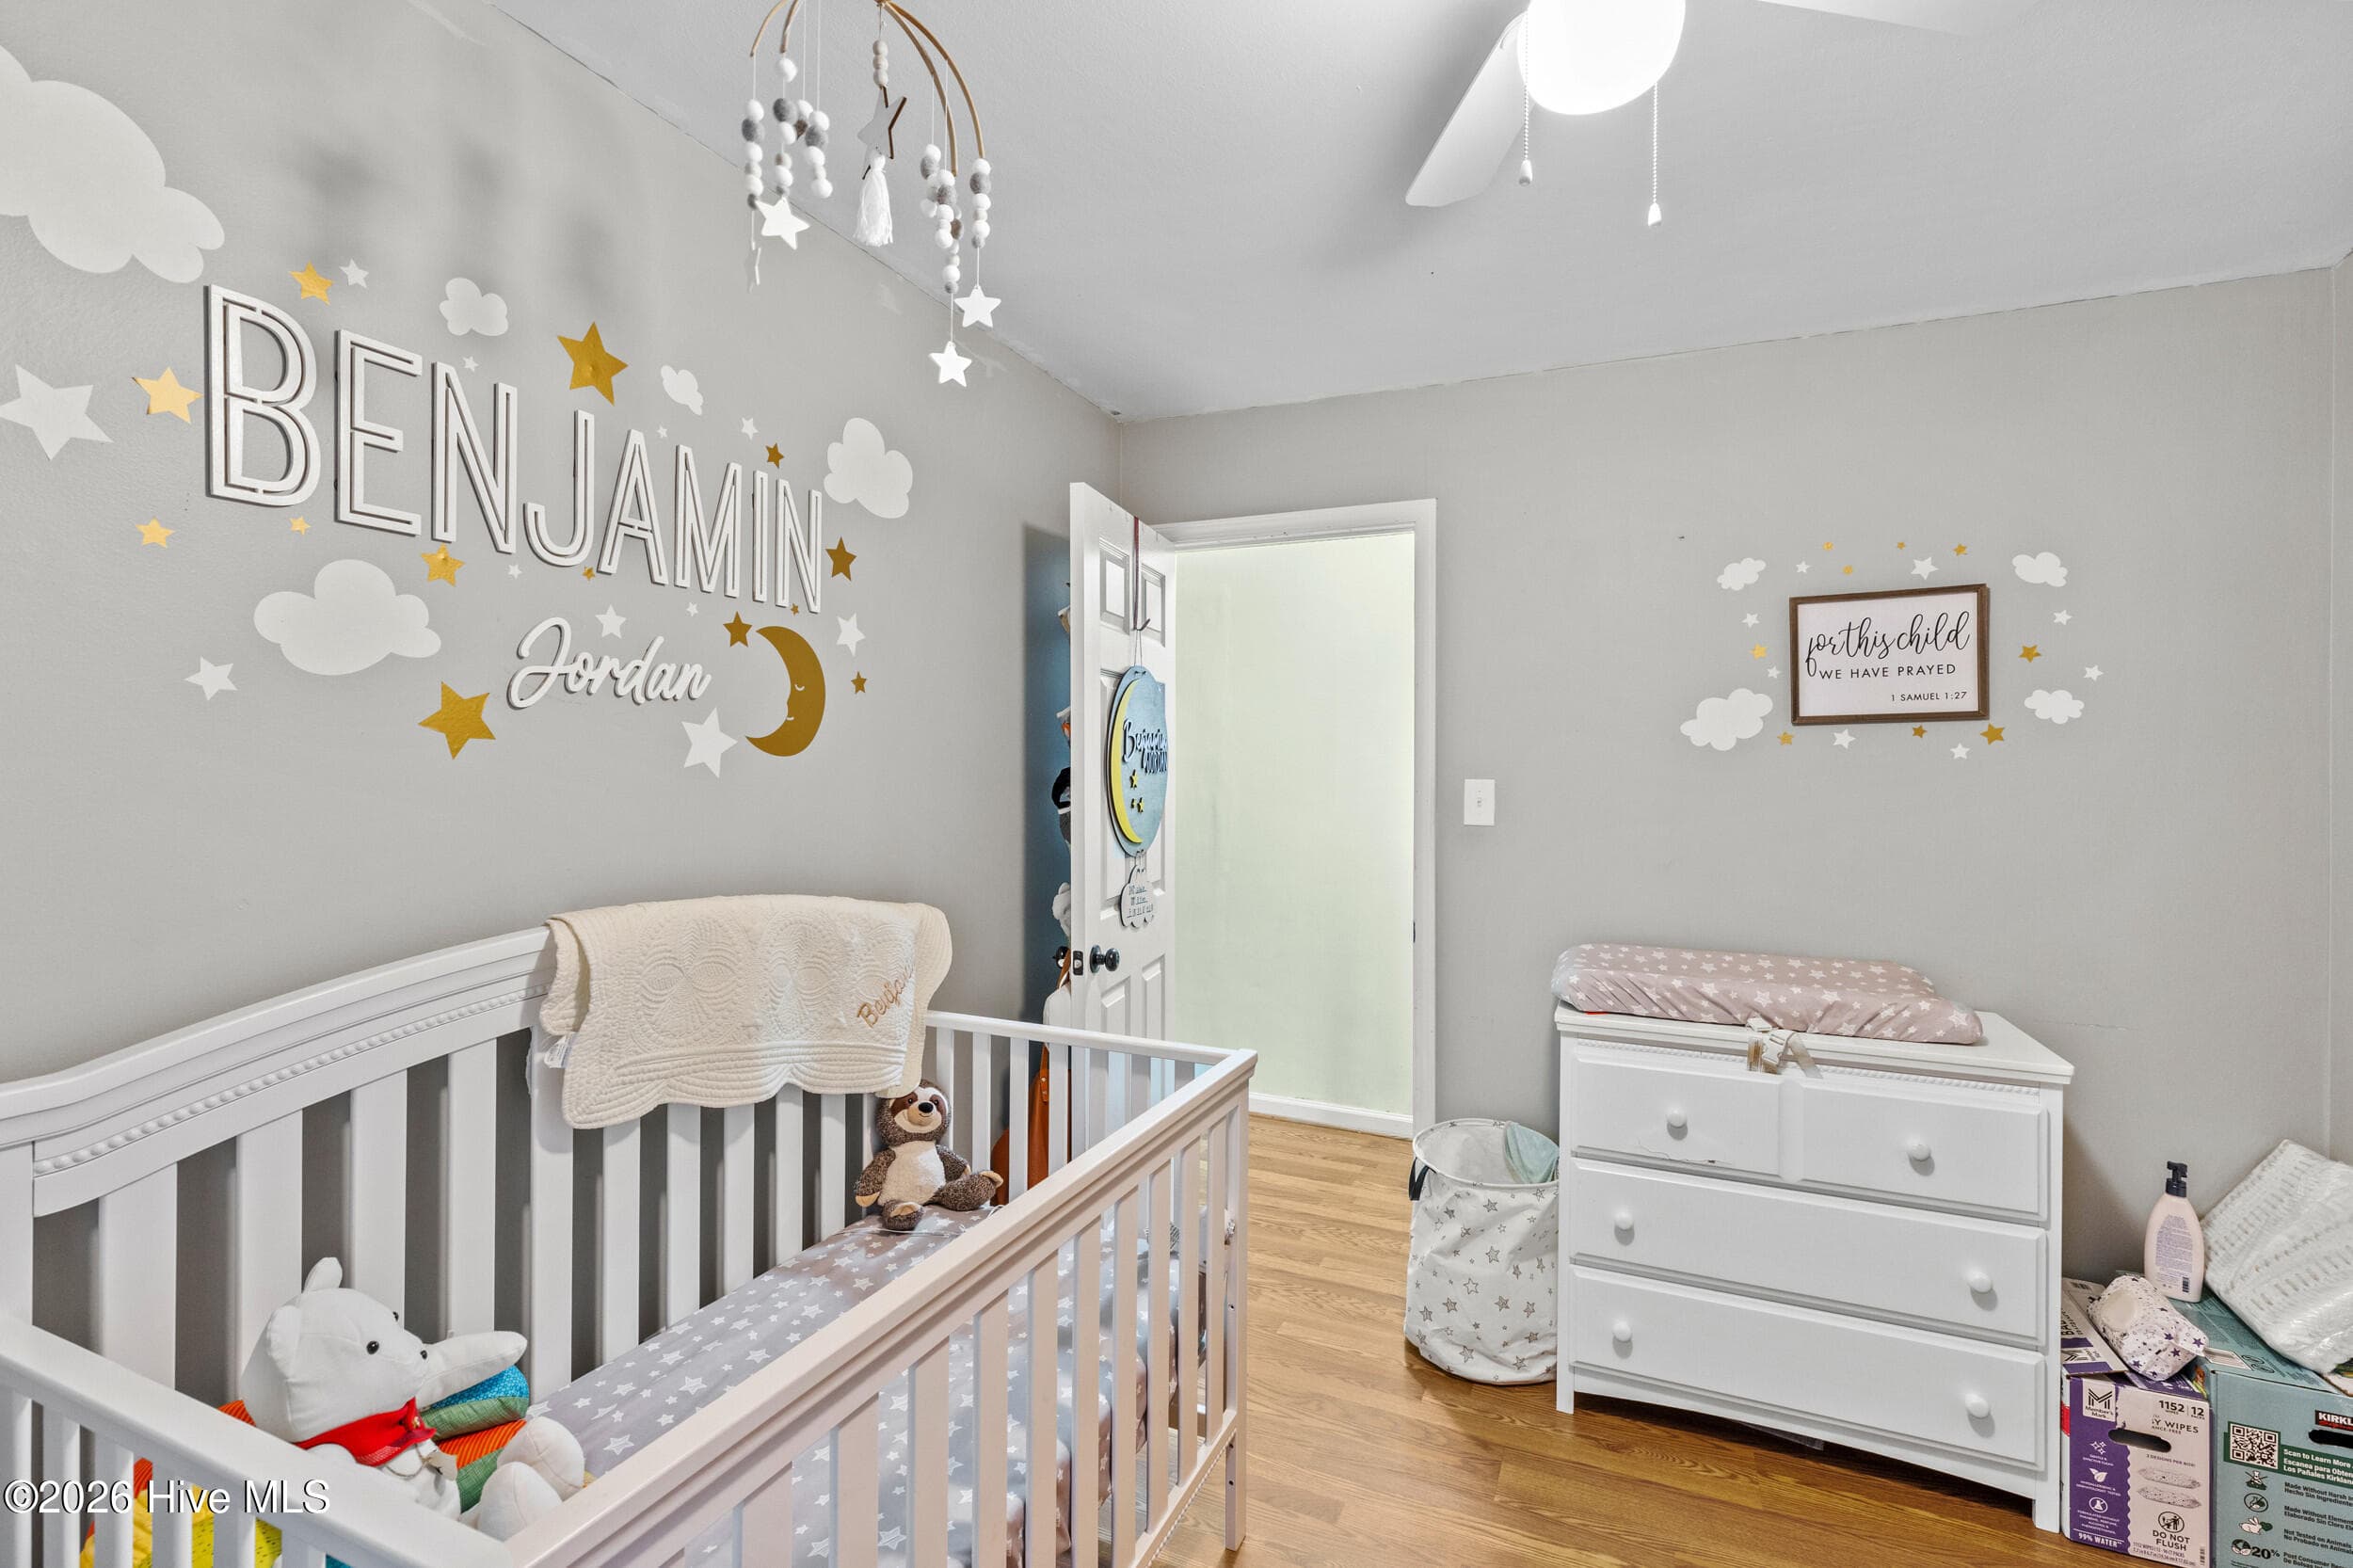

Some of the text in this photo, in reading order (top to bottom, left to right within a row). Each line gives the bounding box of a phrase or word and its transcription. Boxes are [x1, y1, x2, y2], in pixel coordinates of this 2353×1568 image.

[204, 284, 824, 614] BENJAMIN
[1897, 610, 1970, 654] child
[506, 616, 712, 711] Jordan
[1818, 664, 1956, 680] WE HAVE PRAYED
[1900, 692, 1940, 702] SAMUEL
[1945, 690, 1967, 700] 1:27
[2158, 1400, 2185, 1413] 1152
[2191, 1406, 2204, 1416] 12
[2165, 1420, 2199, 1433] WIPES
[2283, 1449, 2301, 1458] Scan
[2311, 1454, 2331, 1464] Learn
[2332, 1459, 2351, 1468] More
[2153, 1529, 2190, 1544] DO NOT
[2156, 1539, 2186, 1551] FLUSH
[2251, 1546, 2281, 1560] 20%
